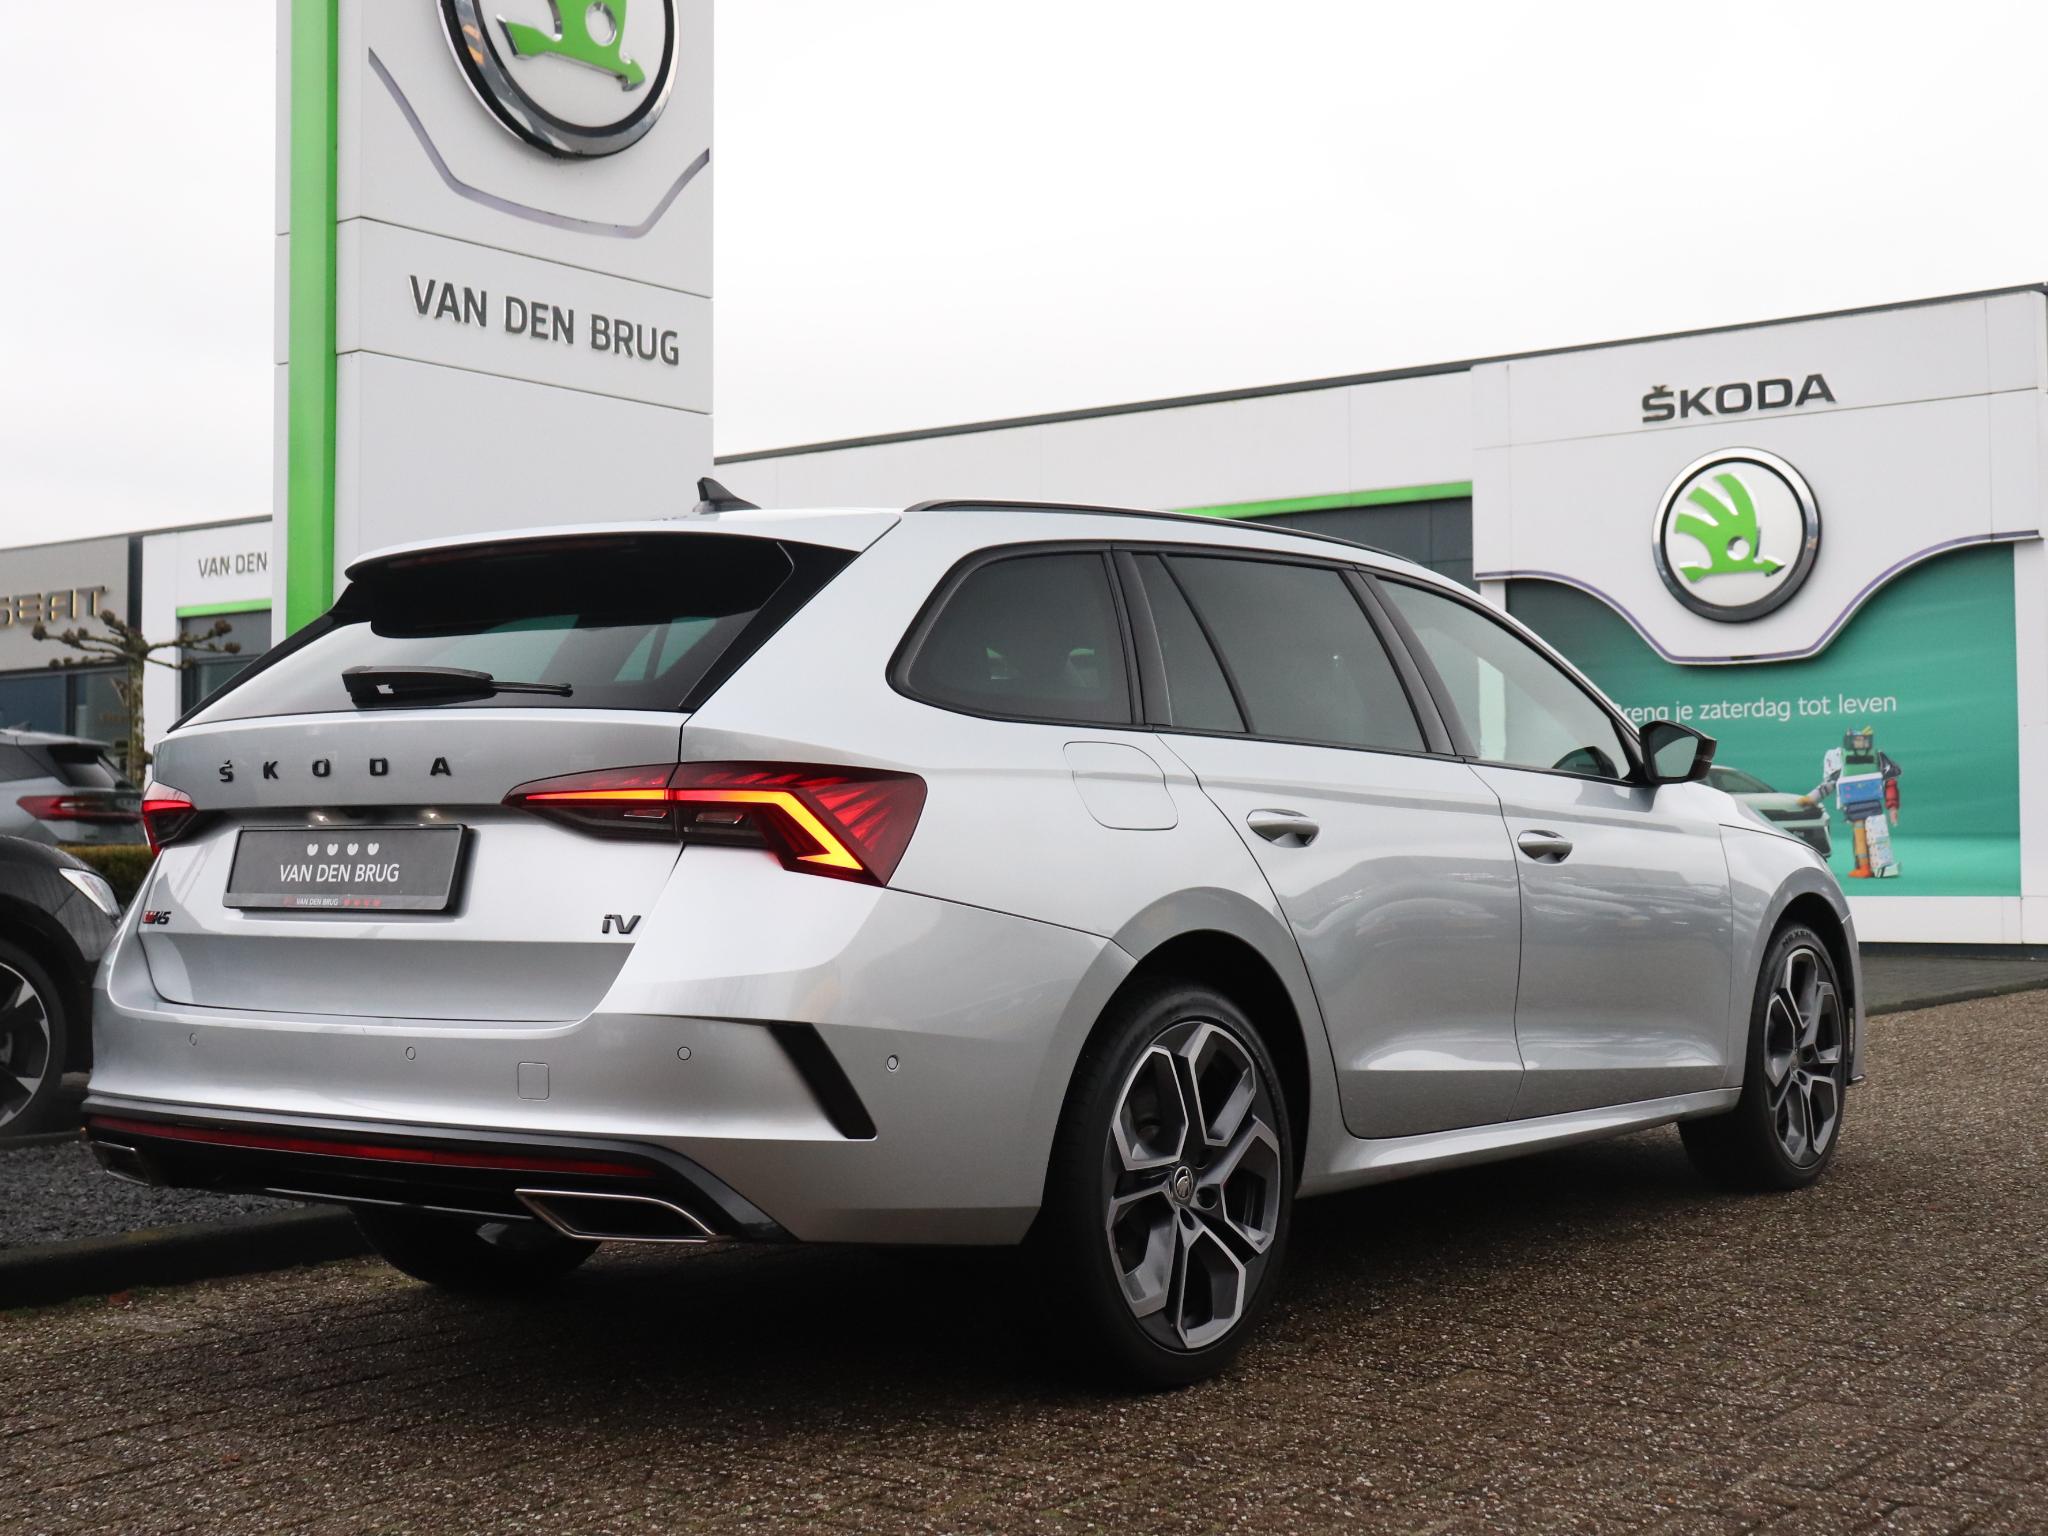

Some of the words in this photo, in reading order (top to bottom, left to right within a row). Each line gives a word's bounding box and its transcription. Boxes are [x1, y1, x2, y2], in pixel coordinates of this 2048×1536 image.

[409, 274, 487, 327] VAN
[504, 296, 574, 344] DEN
[590, 314, 679, 366] BRUG
[1641, 373, 1837, 423] ŠKODA
[198, 556, 230, 577] VAN
[235, 552, 267, 574] DEN
[1675, 700, 1693, 723] je
[1700, 697, 1792, 721] zaterdag
[1798, 696, 1831, 716] tot
[1839, 693, 1897, 714] leven
[280, 864, 312, 882] VAN
[316, 864, 350, 882] DEN
[354, 863, 400, 882] BRUG
[296, 898, 309, 906] VAN
[309, 898, 321, 906] DEN
[322, 898, 339, 906] BRUG
